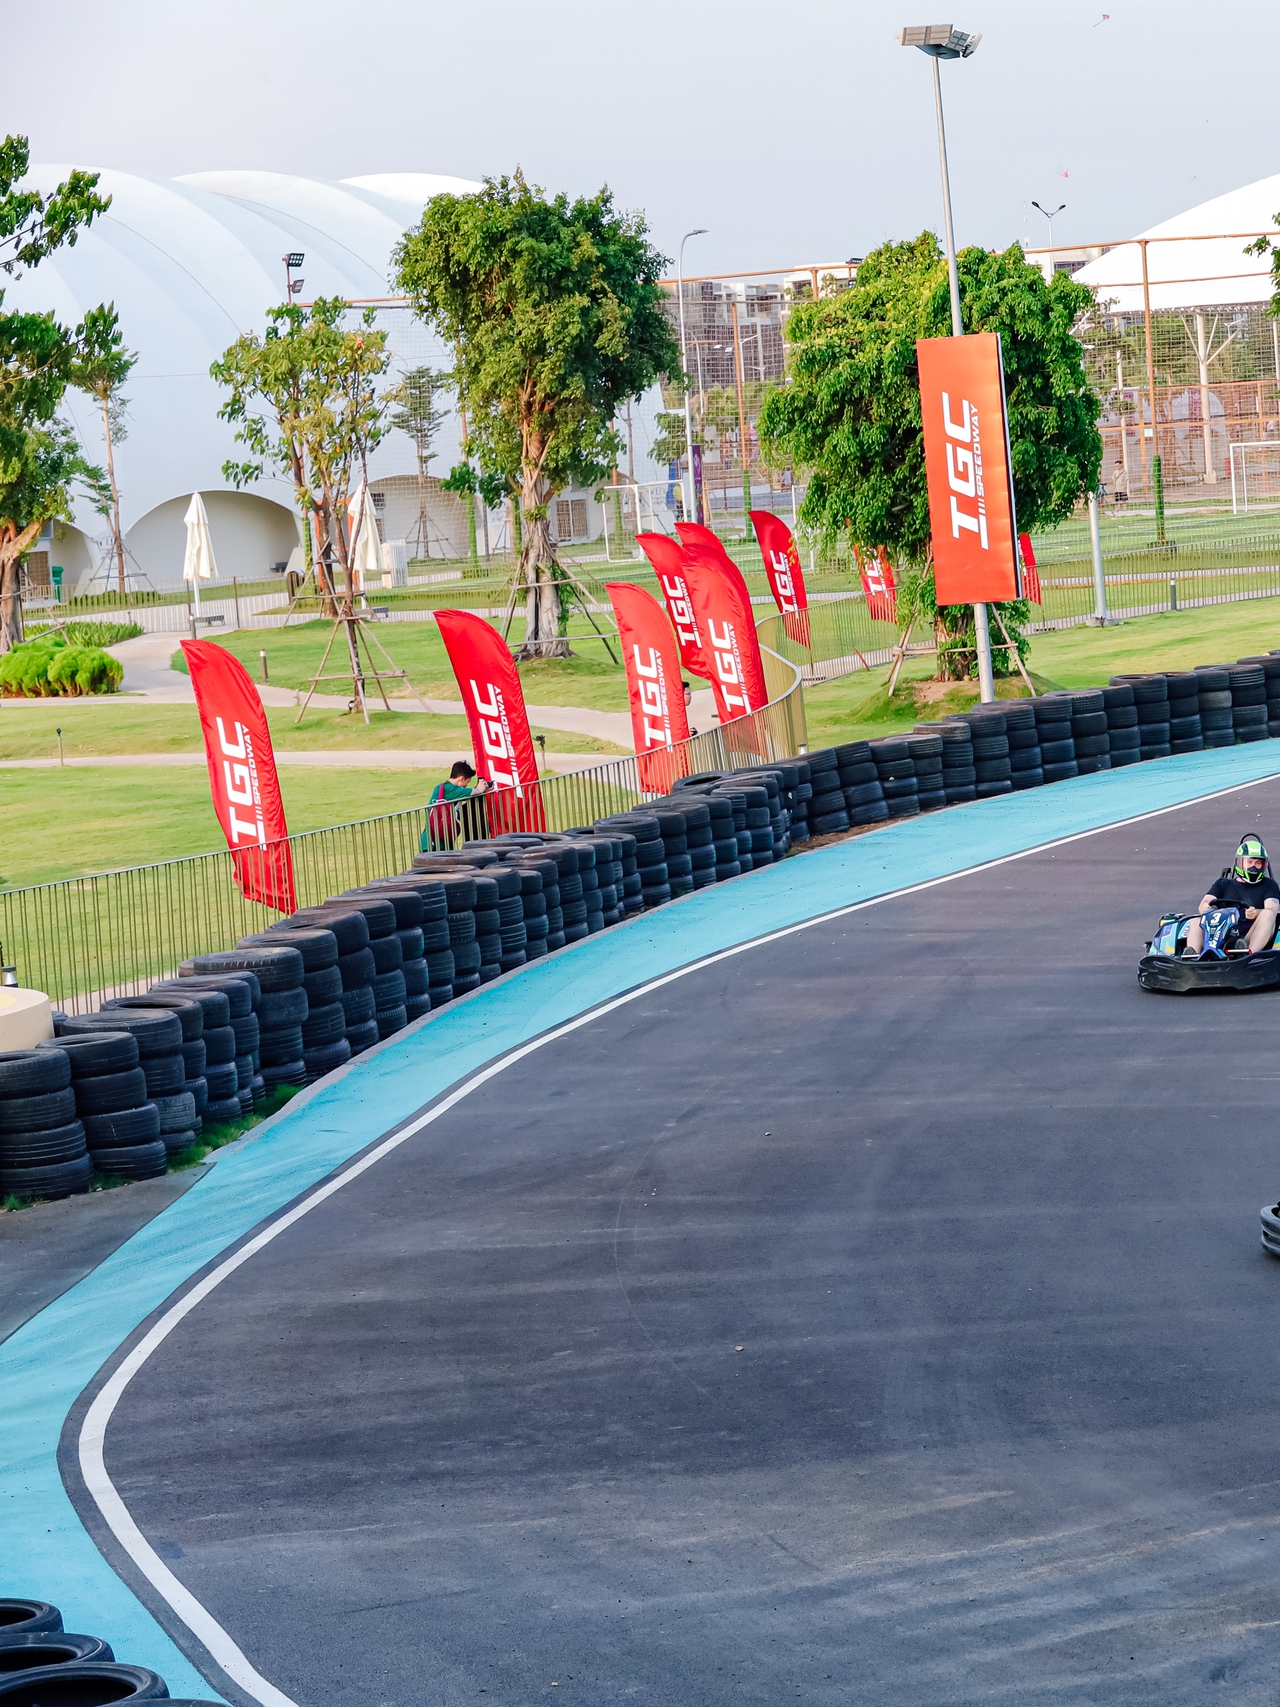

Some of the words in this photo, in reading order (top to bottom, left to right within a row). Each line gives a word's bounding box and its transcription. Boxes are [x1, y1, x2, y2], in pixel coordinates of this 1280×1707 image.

[941, 391, 980, 539] TGC
[969, 403, 985, 497] SPEEDWAY
[662, 574, 697, 647] TGC
[678, 576, 696, 623] SPEEDWAY
[769, 549, 796, 614] TGC
[653, 649, 669, 716] SPEEDWAY
[708, 618, 745, 713] TGC
[728, 622, 745, 683] SPEEDWAY
[493, 685, 516, 758] SPEEDWAY
[633, 644, 667, 748] TGC
[240, 724, 263, 805] SPEEDWAY
[469, 679, 514, 793] TGC
[216, 716, 258, 843] TGC
[1209, 912, 1222, 924] 3
